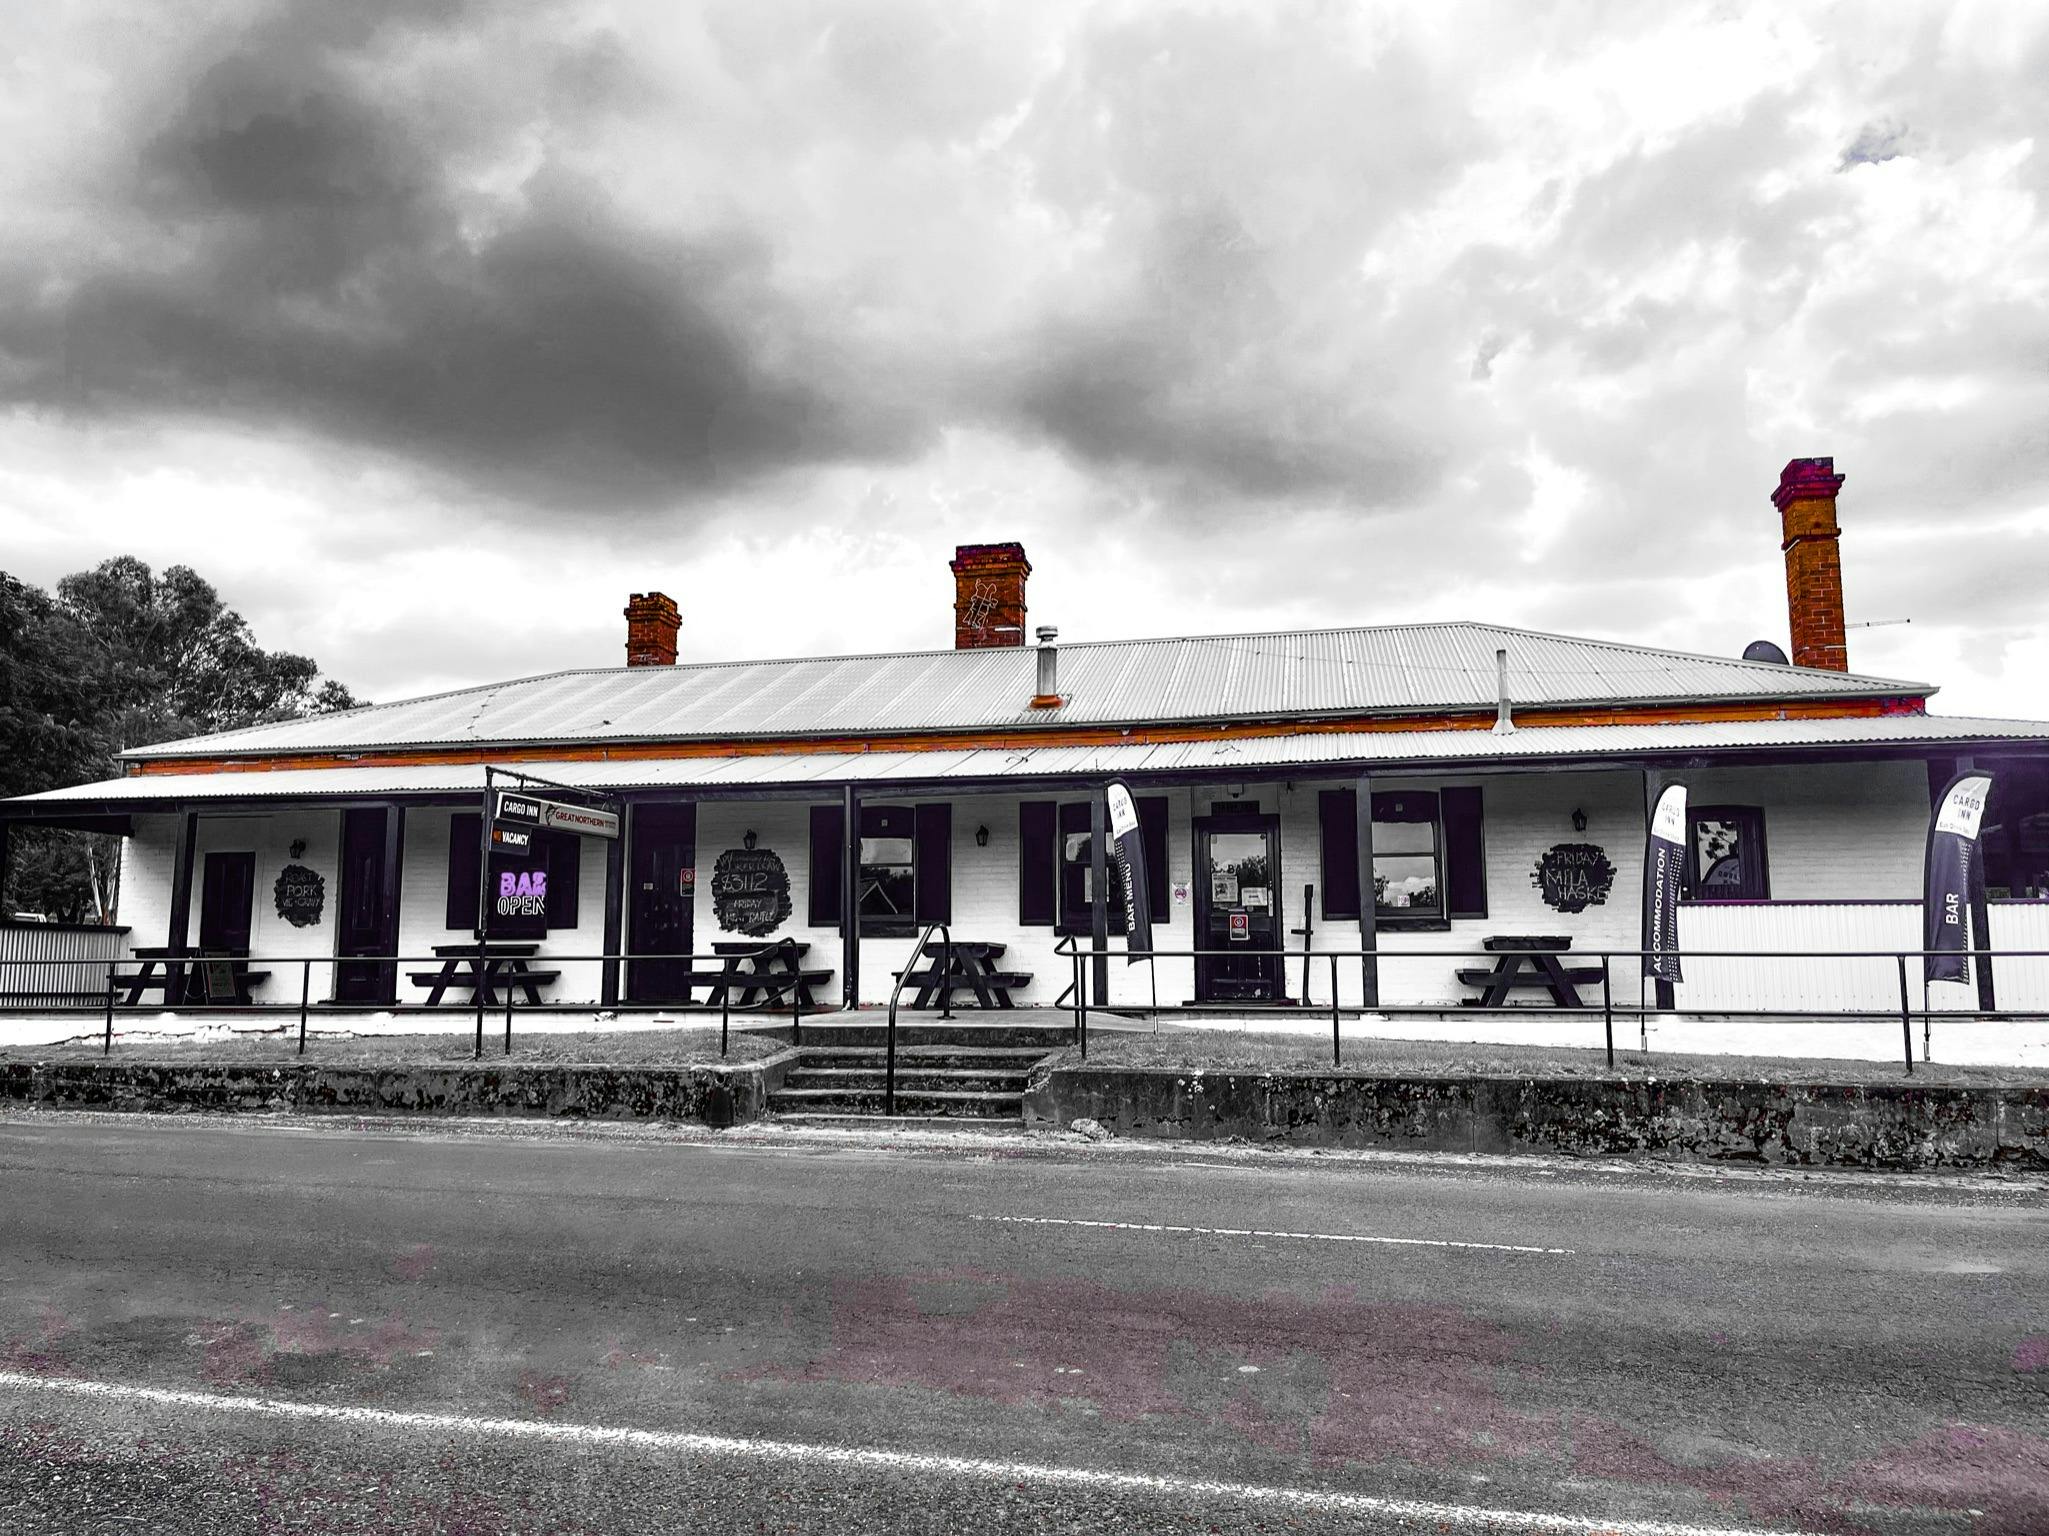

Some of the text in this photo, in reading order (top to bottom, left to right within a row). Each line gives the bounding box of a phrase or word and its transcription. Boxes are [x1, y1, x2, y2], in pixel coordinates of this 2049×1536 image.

[503, 801, 539, 817] CARGO INN
[1953, 794, 1981, 811] CARGO
[1957, 808, 1972, 821] INN
[502, 831, 529, 846] VACANCY
[1557, 851, 1599, 867] FRIDAY
[286, 884, 317, 897] PORK
[1125, 863, 1136, 931] BAR MENU
[497, 895, 545, 916] OPEN
[1653, 847, 1666, 973] ACCOMMODATION
[1945, 893, 1959, 925] BAR
